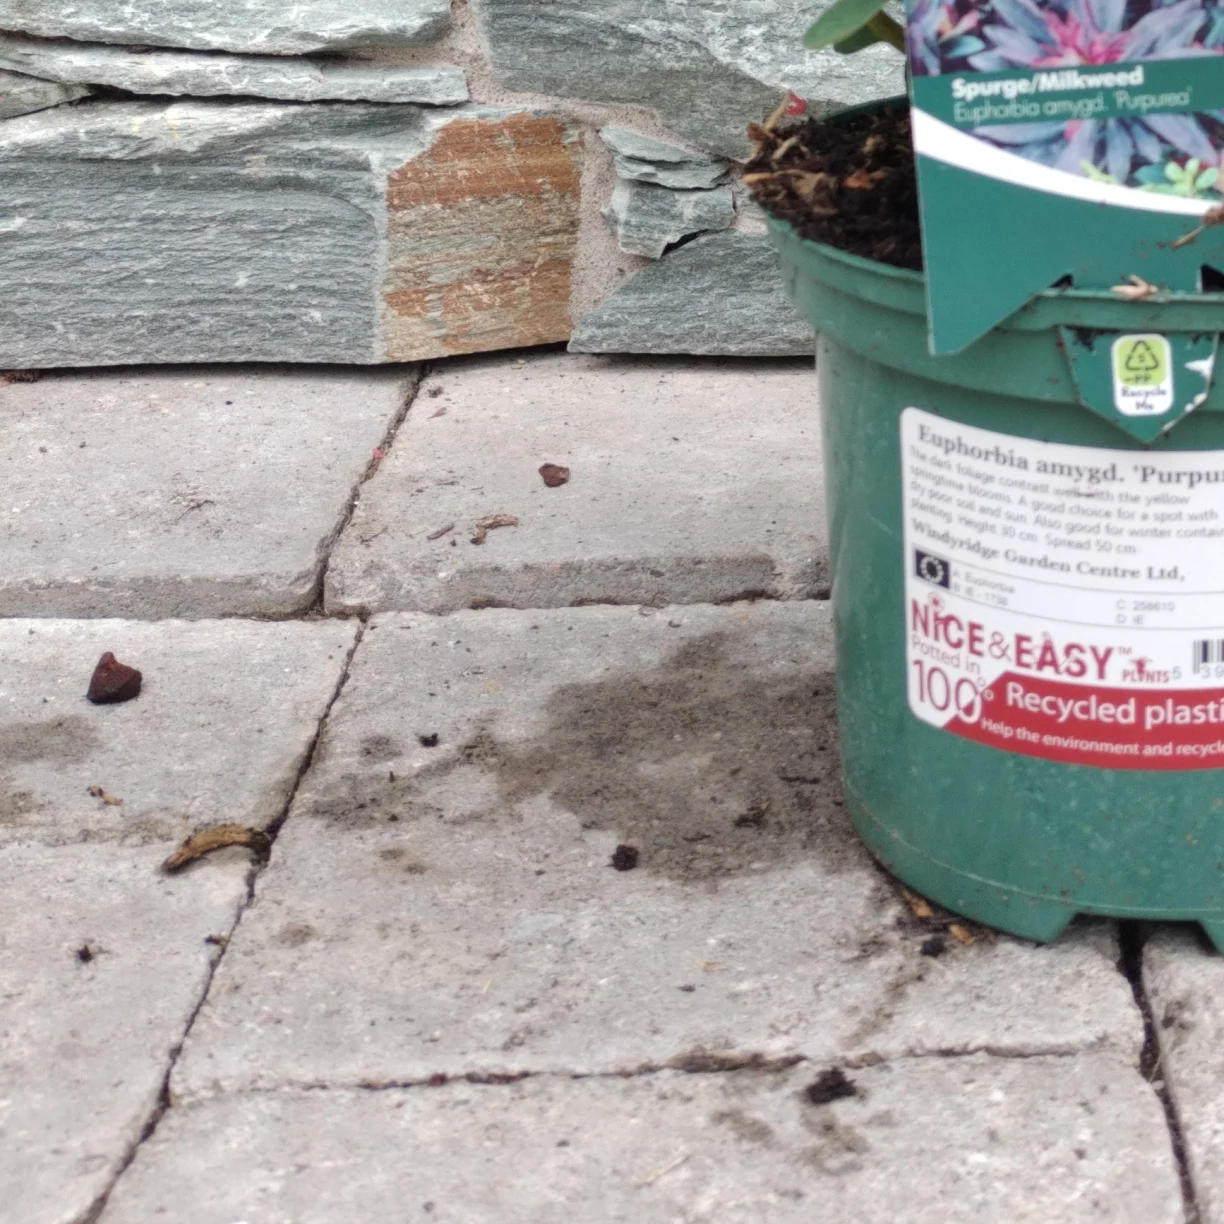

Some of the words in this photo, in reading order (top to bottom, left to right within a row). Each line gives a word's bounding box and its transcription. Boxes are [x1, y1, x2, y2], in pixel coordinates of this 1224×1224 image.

[951, 64, 1144, 102] Spurge/Milkweed
[953, 98, 1041, 126] Euphorbia
[1043, 92, 1109, 117] amygd.
[918, 424, 1029, 471] Euphorbia
[1036, 458, 1125, 485] amygd.
[910, 464, 965, 492] springtime
[1018, 495, 1028, 507] A
[1031, 498, 1065, 515] good
[1068, 502, 1112, 520] choice
[1117, 507, 1136, 521] for
[1140, 512, 1149, 522] a
[1153, 511, 1184, 524] spot
[1188, 508, 1219, 522] with
[930, 455, 952, 471] dark
[957, 462, 996, 484] foliage
[998, 476, 1049, 494] contrast
[1118, 491, 1140, 504] the
[1144, 491, 1190, 508] yellow
[956, 497, 975, 511] soil
[979, 504, 1002, 519] and
[1034, 514, 1062, 530] Also
[1065, 522, 1100, 536] good
[1104, 523, 1124, 536] for
[1128, 526, 1172, 539] winter
[957, 514, 996, 535] Height
[1045, 532, 1091, 550] Spread
[1095, 538, 1112, 553] 50
[912, 517, 999, 560] Windyridge
[1004, 548, 1071, 572] Garden
[1076, 560, 1141, 580] Centre
[912, 634, 961, 669] Potted
[966, 656, 981, 675] in
[1006, 681, 1136, 724] Recycled
[981, 717, 1014, 739] Help
[1015, 727, 1040, 744] the
[1042, 733, 1139, 755] environment
[1142, 742, 1173, 756] and
